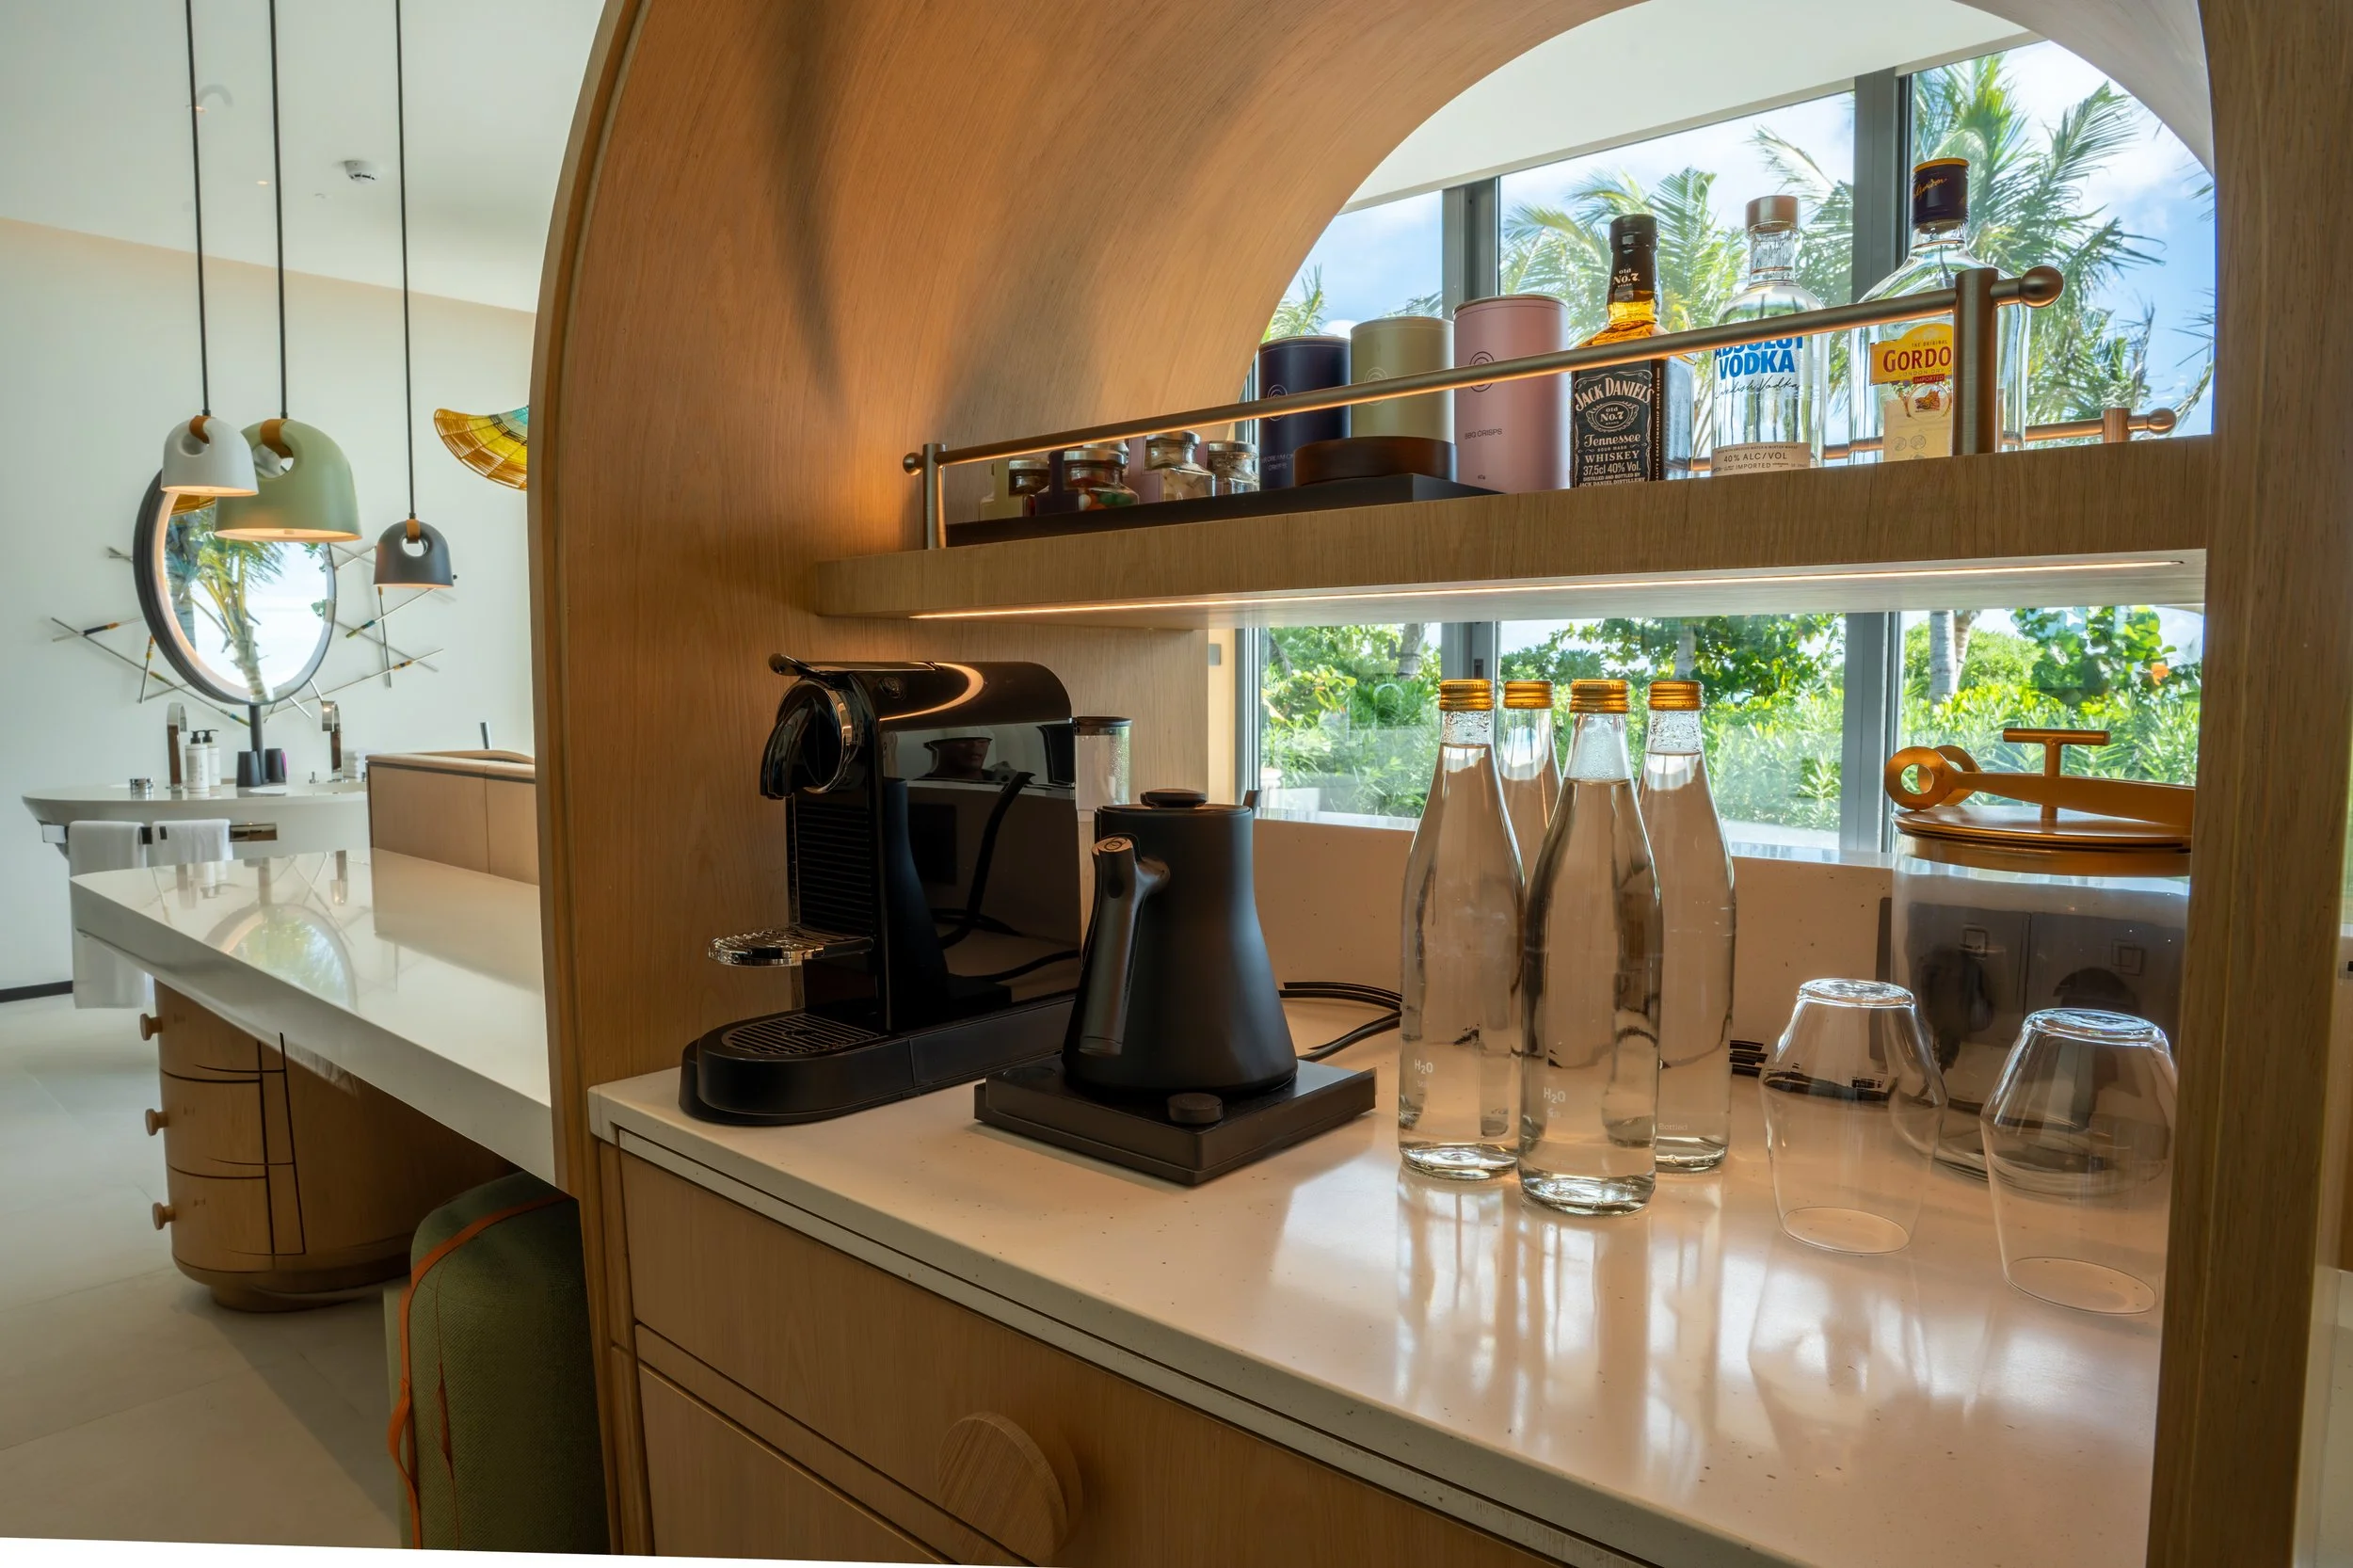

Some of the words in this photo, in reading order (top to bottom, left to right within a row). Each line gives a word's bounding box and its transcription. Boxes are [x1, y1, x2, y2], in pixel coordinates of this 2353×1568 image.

[1719, 349, 1796, 380] VODKA
[1883, 345, 1952, 373] GORDO
[1575, 384, 1604, 411] JACK
[1605, 377, 1655, 404] DANIEL'S
[1478, 428, 1502, 437] CRISPS
[1584, 434, 1641, 447] Tennessee
[1585, 451, 1640, 463] WHISKEY
[1723, 454, 1740, 463] 40%
[1608, 463, 1625, 473] 40%
[1626, 461, 1641, 471] Vol.
